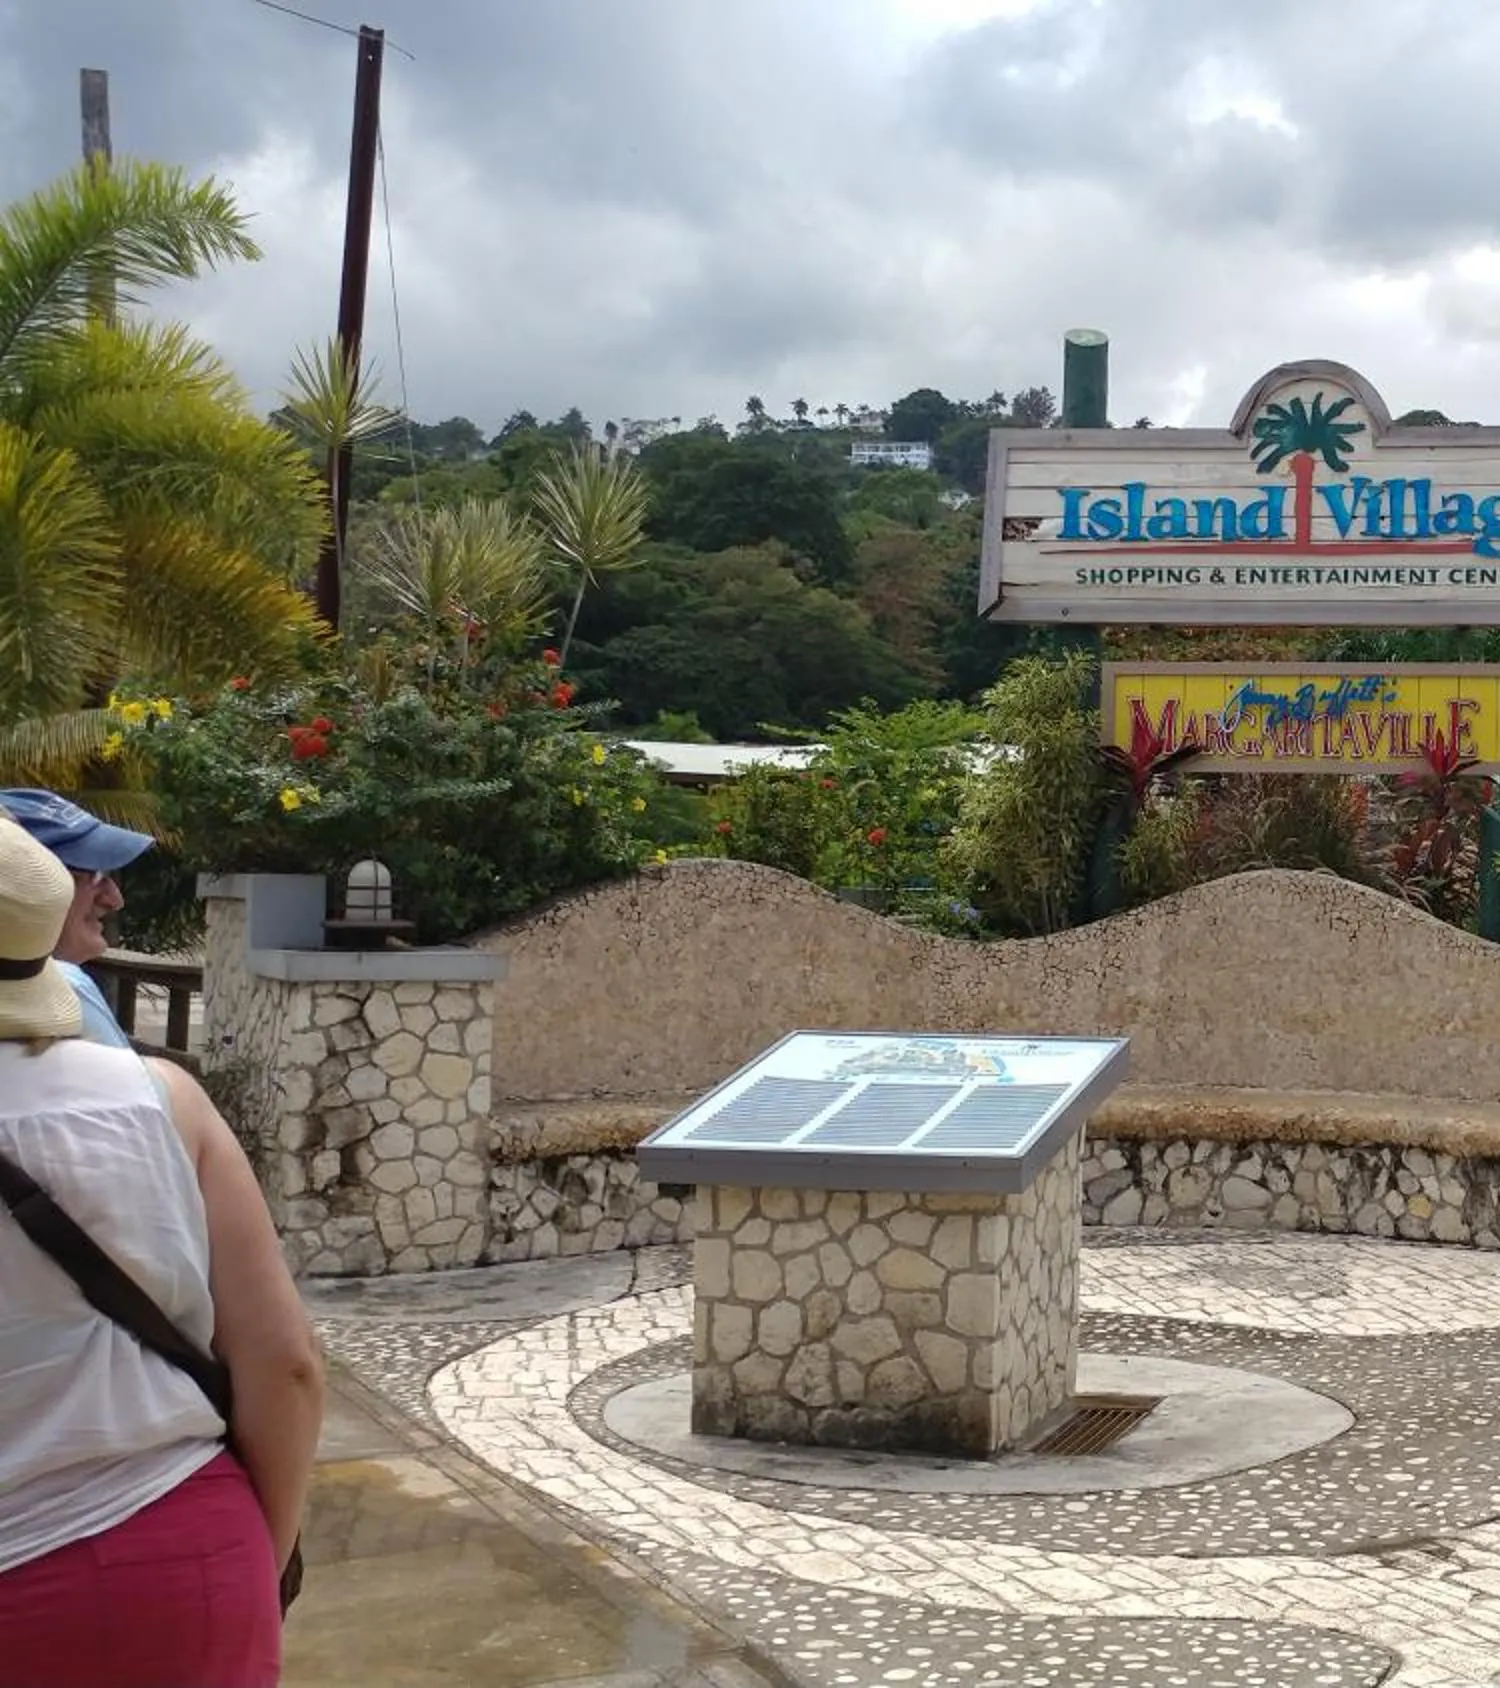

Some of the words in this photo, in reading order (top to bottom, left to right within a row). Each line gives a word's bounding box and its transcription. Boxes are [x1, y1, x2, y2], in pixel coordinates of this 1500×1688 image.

[1056, 480, 1289, 543] Island
[1075, 567, 1201, 585] SHOPPING
[1209, 566, 1226, 585] &
[1235, 567, 1441, 585] ENTERTAINMENT
